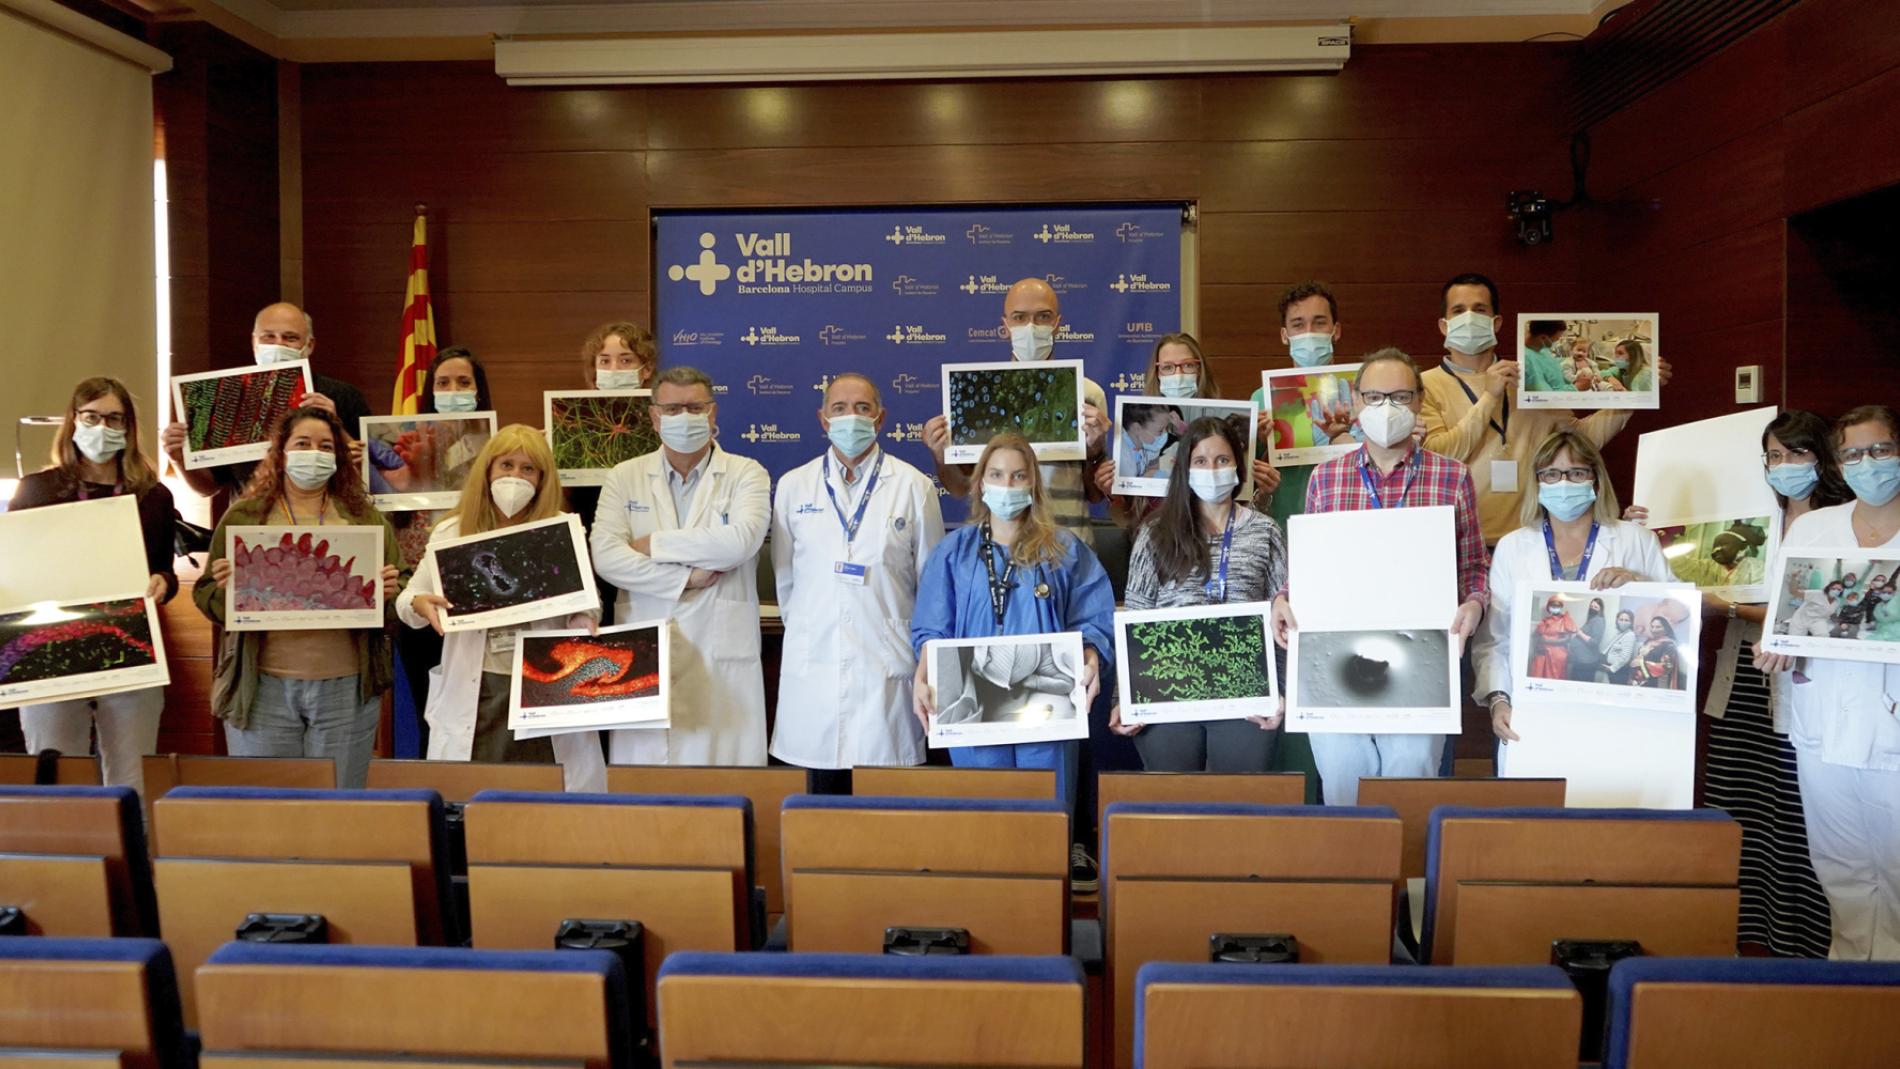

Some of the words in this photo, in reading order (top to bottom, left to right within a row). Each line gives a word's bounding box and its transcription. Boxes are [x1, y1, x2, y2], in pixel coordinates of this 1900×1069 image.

[1054, 224, 1070, 232] Vall
[905, 233, 946, 241] d'Hebron
[1053, 231, 1095, 239] d'Hebron
[736, 232, 791, 256] Vall
[736, 258, 873, 283] d'Hebron
[1130, 274, 1147, 282] Vall
[738, 284, 790, 294] Barcelona
[793, 283, 832, 294] Hospital
[834, 283, 873, 294] Campus
[1129, 281, 1170, 289] d'Hebron
[906, 325, 922, 333] Vall
[968, 327, 997, 337] Cemcat
